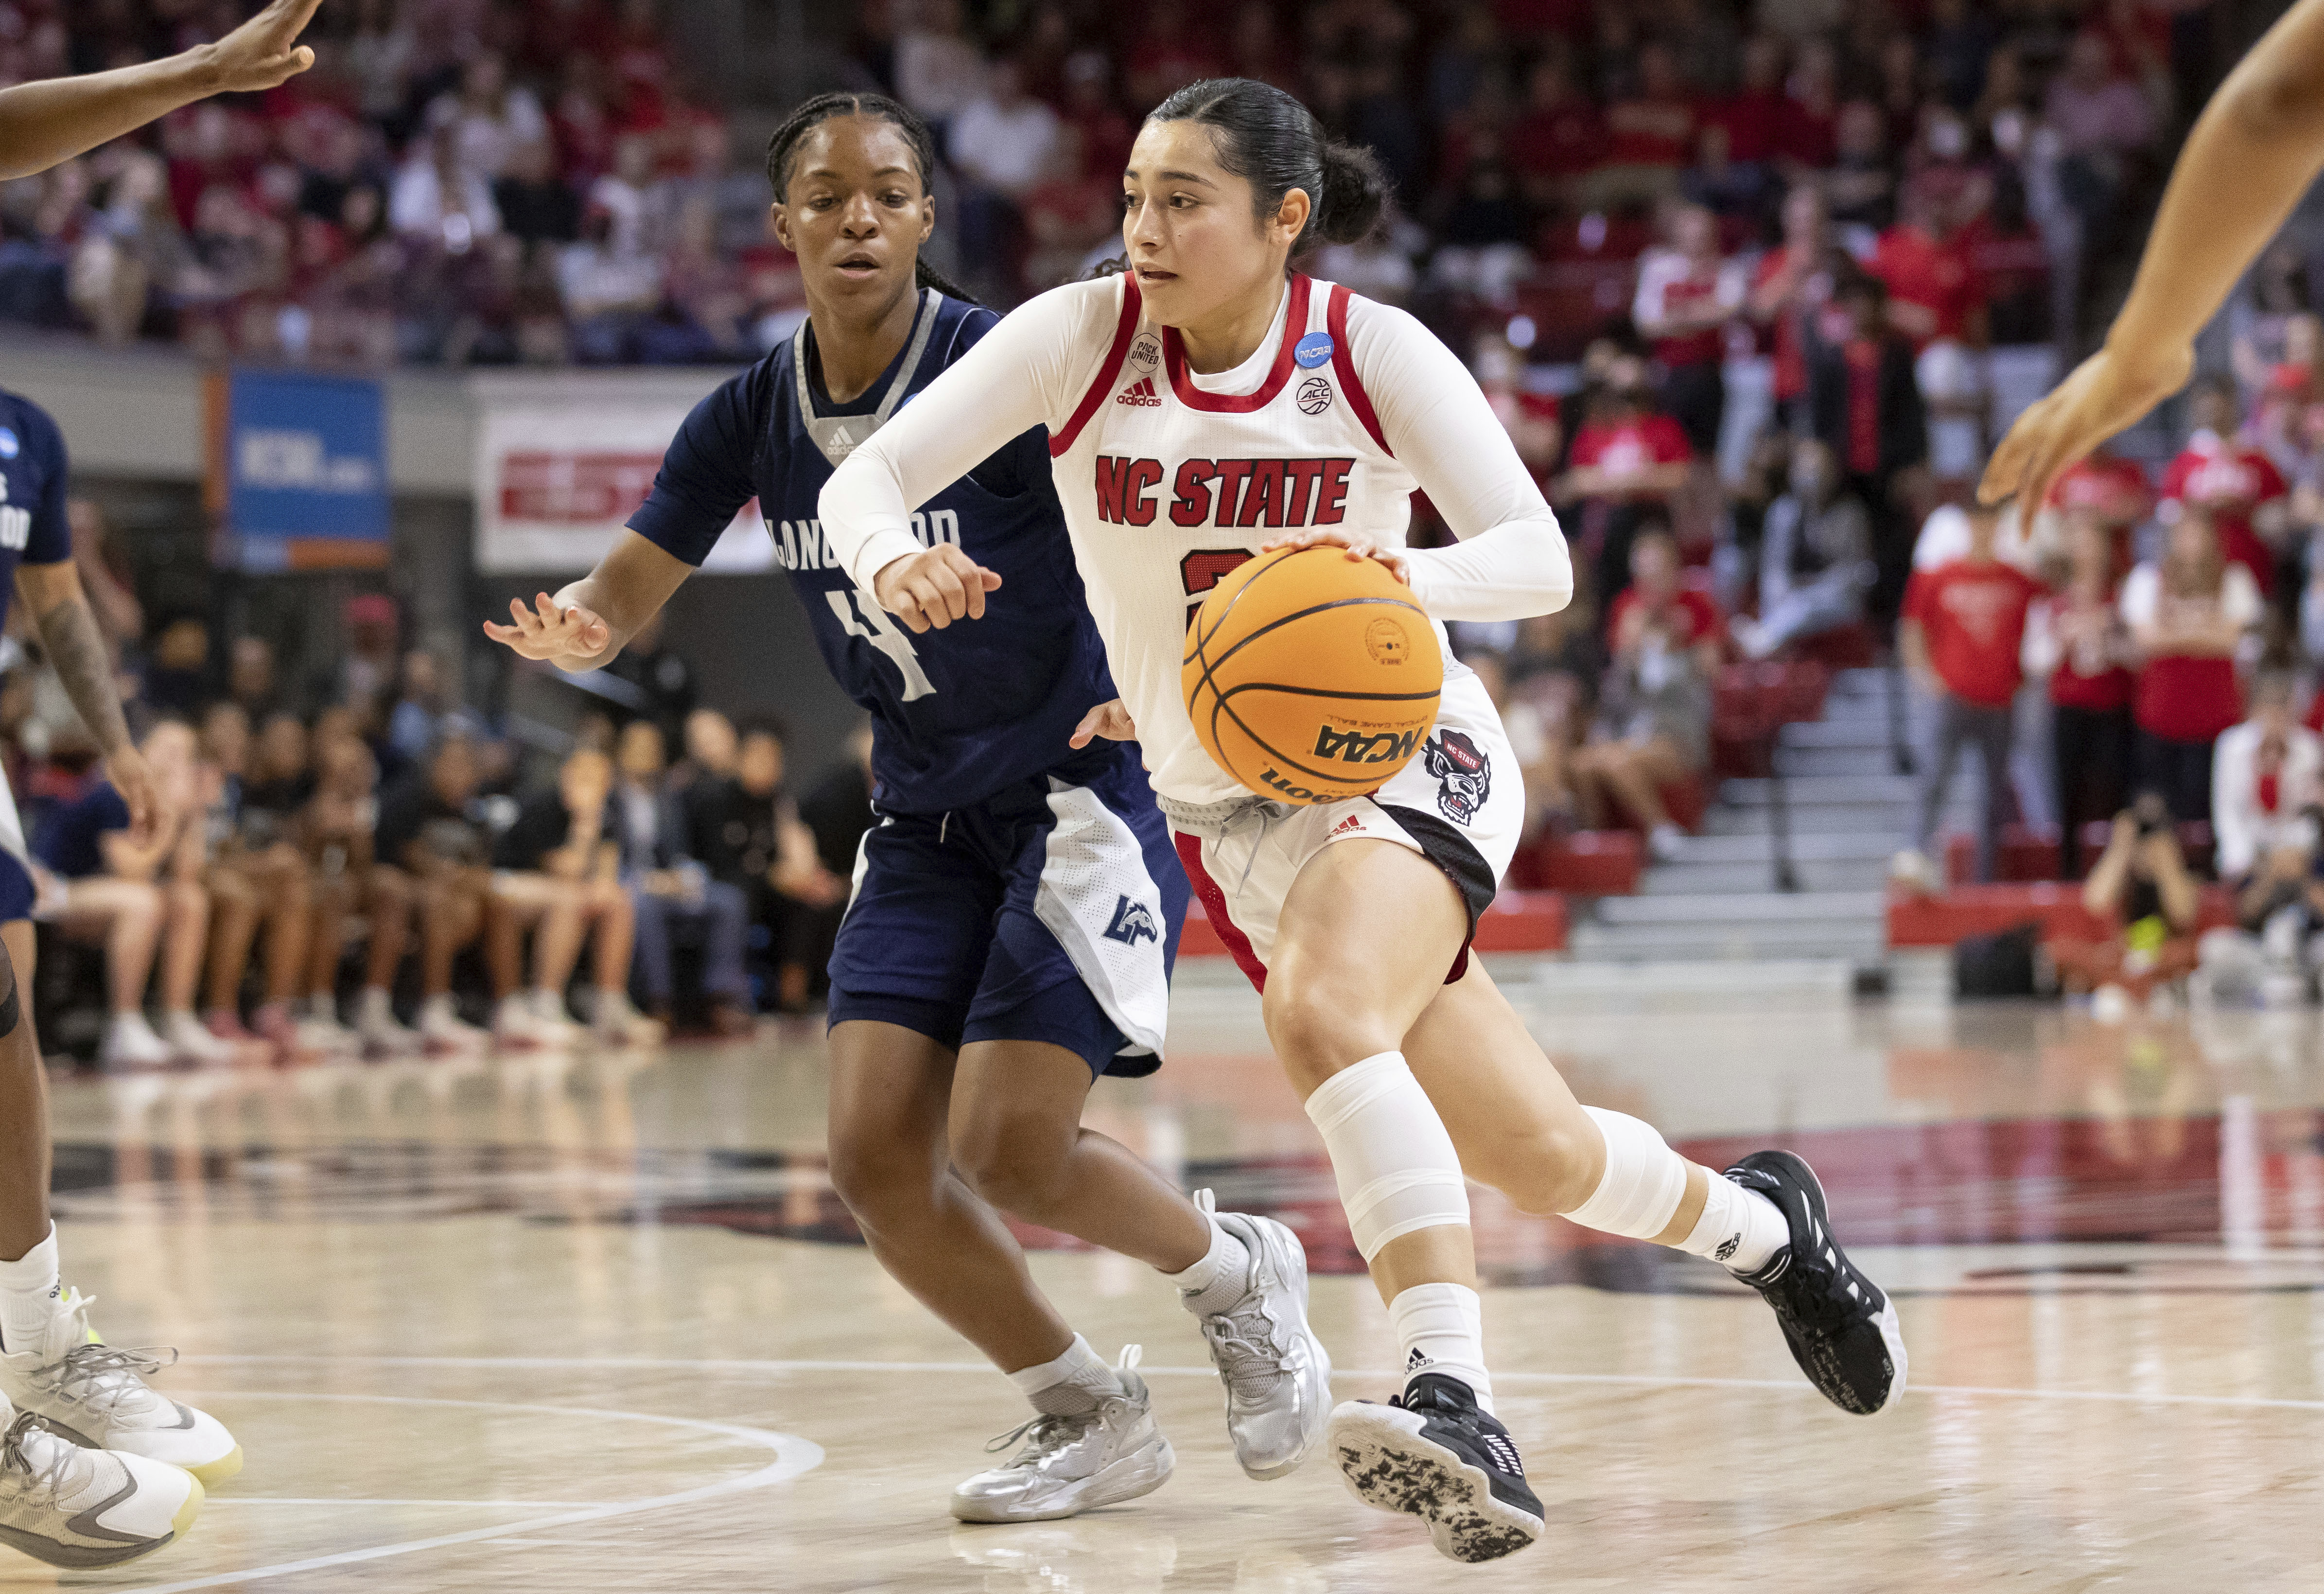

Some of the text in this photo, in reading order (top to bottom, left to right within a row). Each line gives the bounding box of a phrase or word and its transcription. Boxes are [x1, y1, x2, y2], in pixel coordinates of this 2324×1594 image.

[1137, 342, 1158, 355] PACK
[1299, 345, 1331, 360] NCAA
[1131, 350, 1159, 364] UNITED
[1117, 394, 1162, 406] adidas
[1300, 387, 1330, 400] ACC
[1095, 455, 1357, 527] NC STATE
[1313, 724, 1424, 764] NCAA
[1447, 743, 1477, 768] NC STATE
[1324, 826, 1367, 841] adidas
[1715, 1232, 1741, 1261] adidas
